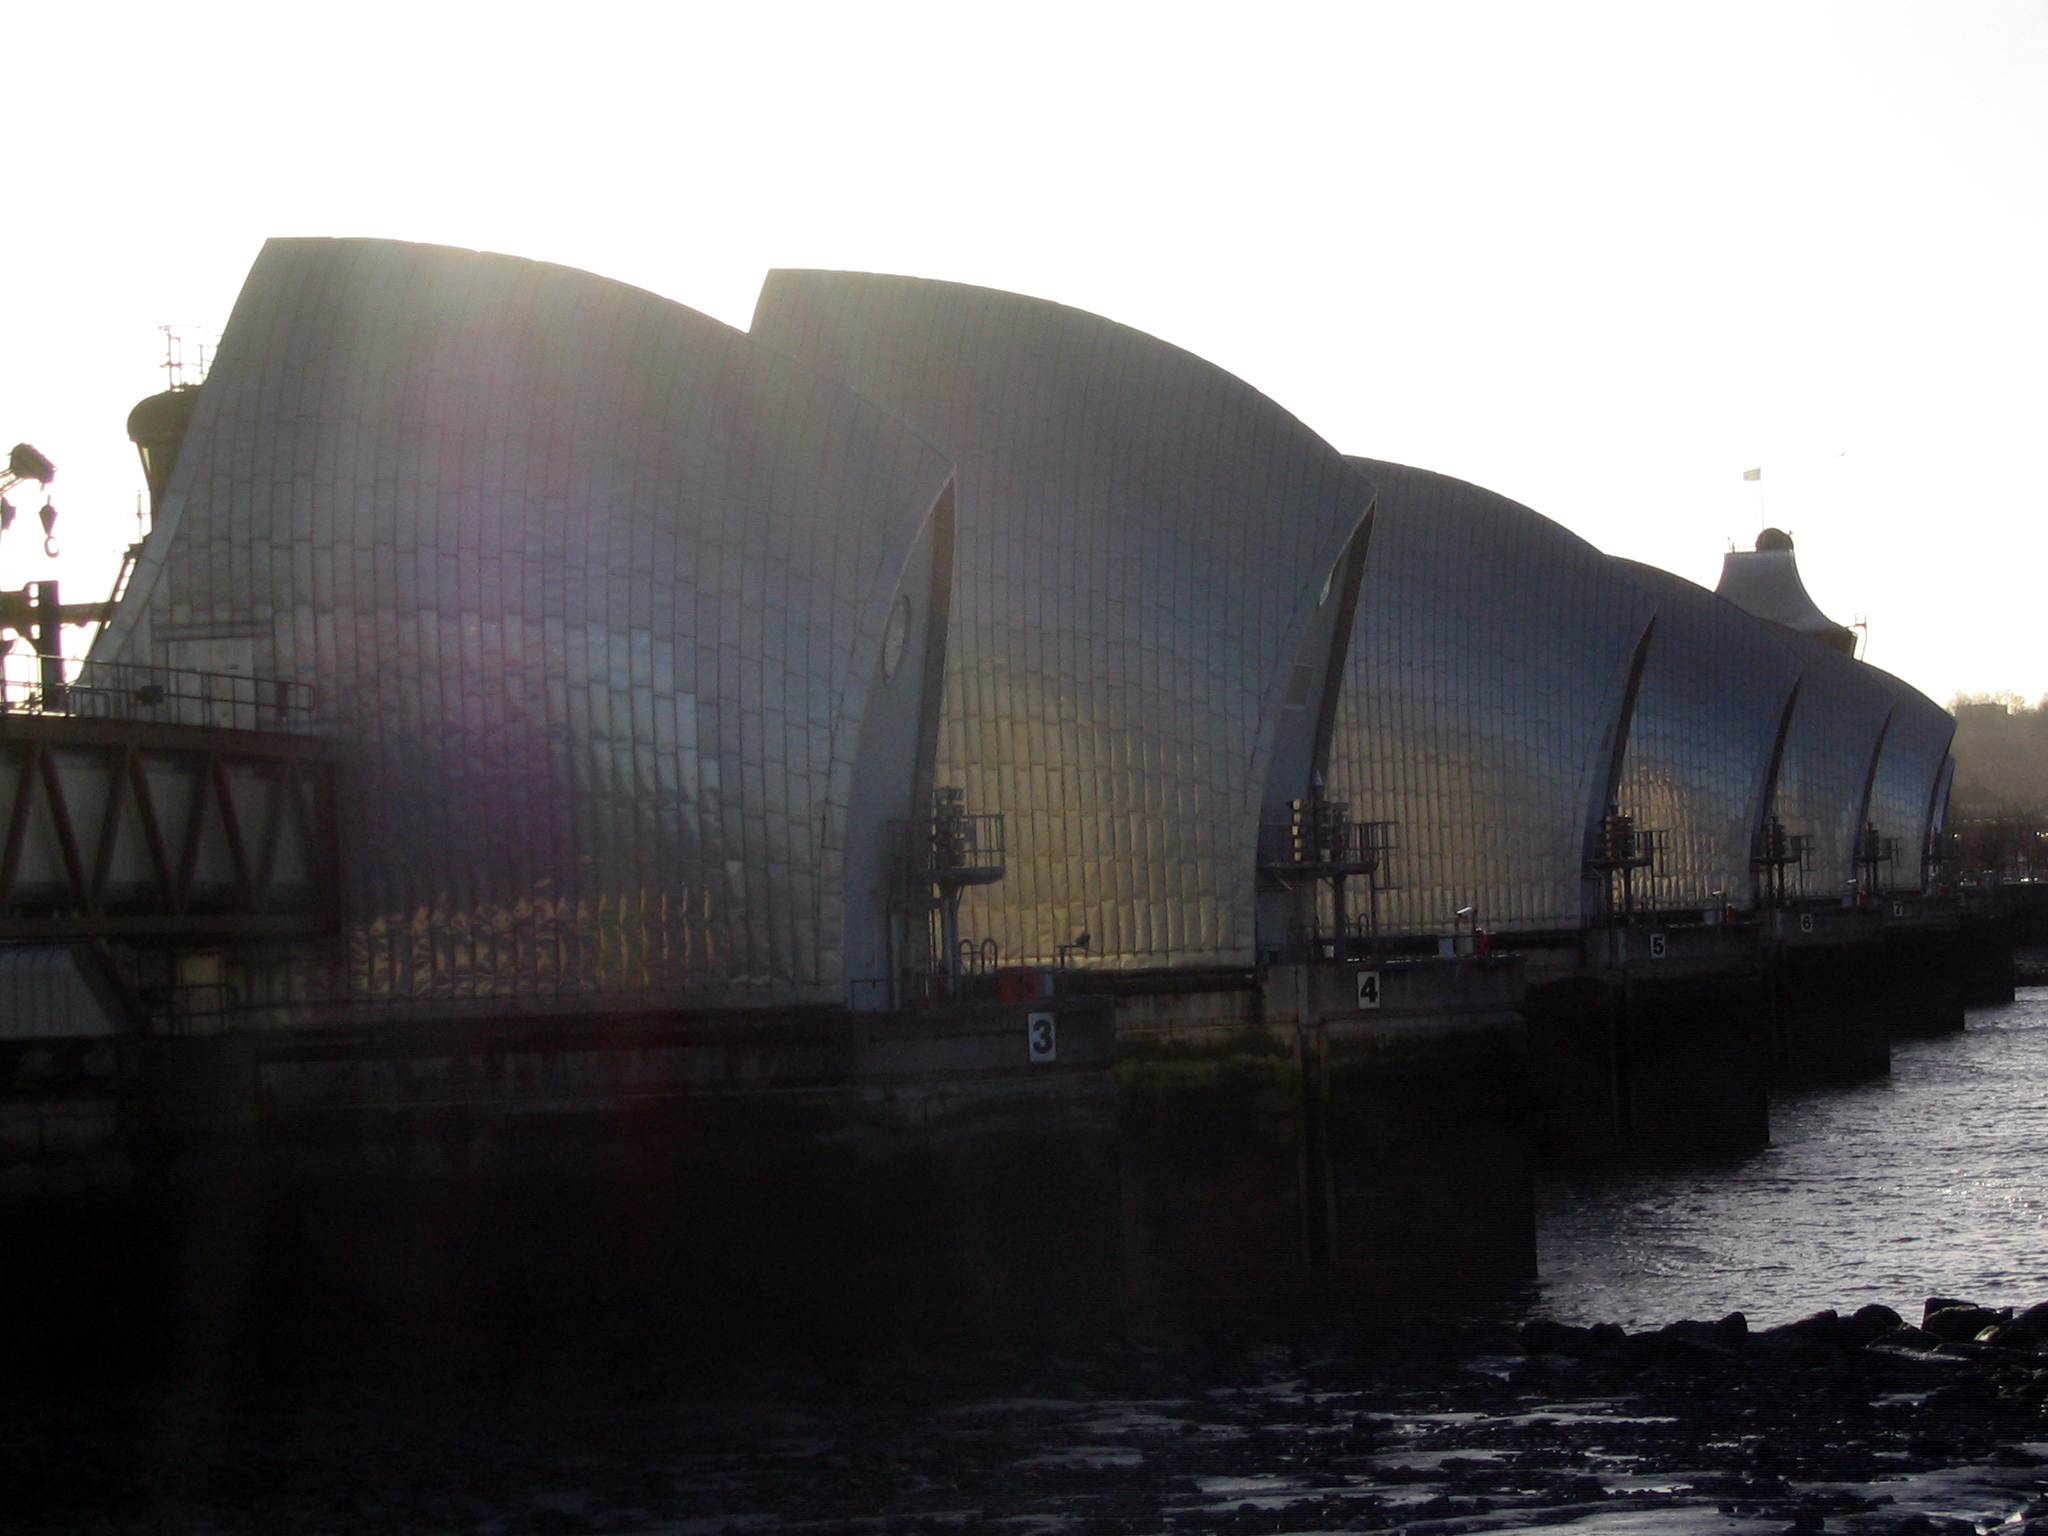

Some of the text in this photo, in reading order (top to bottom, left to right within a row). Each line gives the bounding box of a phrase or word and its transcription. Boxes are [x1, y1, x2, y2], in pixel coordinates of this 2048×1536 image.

[1653, 937, 1664, 955] 5
[1360, 976, 1378, 1003] 4
[1033, 1019, 1054, 1055] 3
